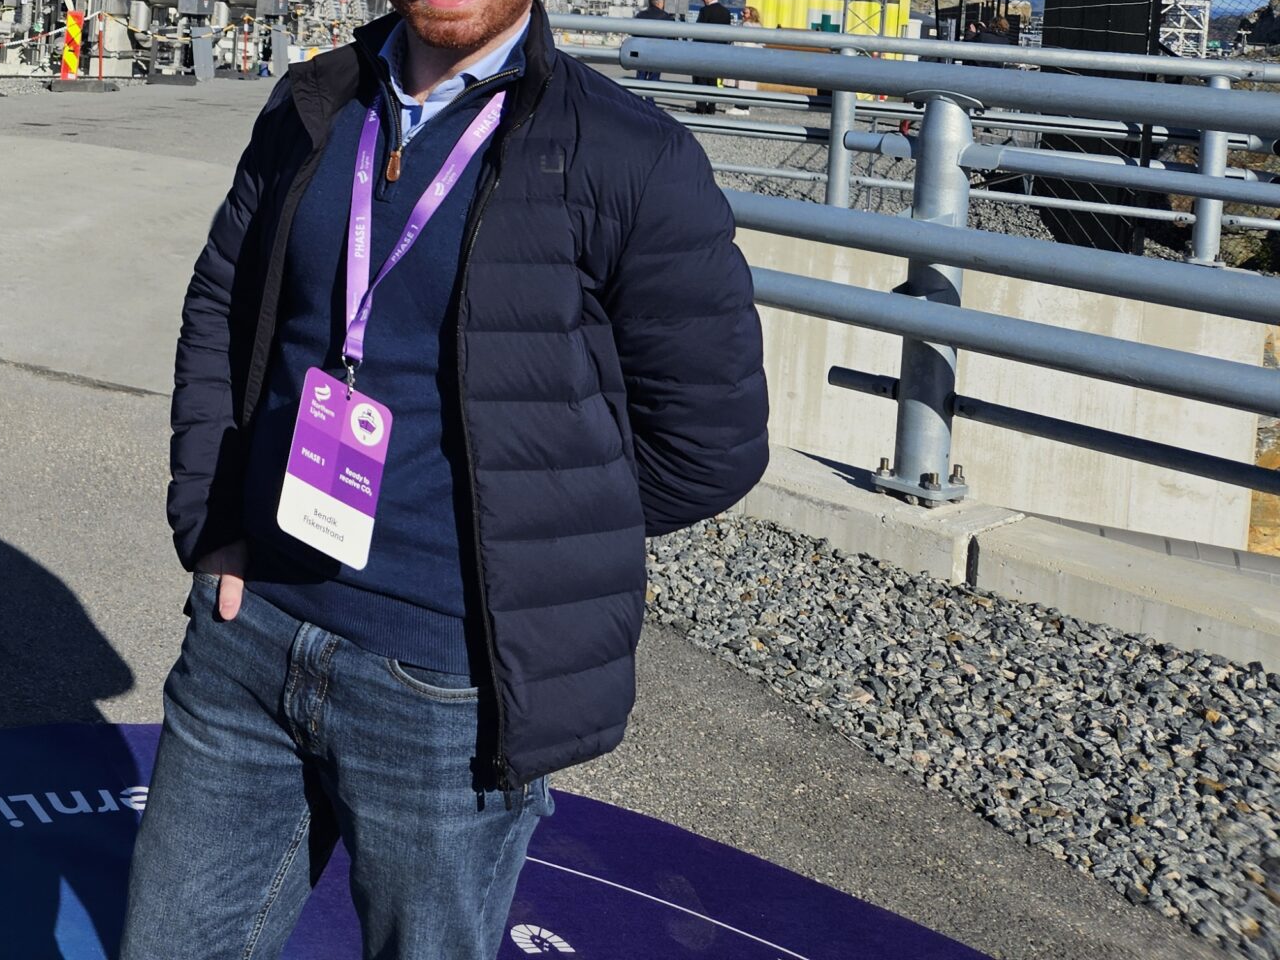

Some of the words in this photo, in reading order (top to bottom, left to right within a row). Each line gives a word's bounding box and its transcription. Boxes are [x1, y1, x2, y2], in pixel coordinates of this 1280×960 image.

[473, 109, 500, 138] PHASE
[354, 225, 366, 258] PHASE
[391, 232, 415, 262] PHASE
[301, 447, 321, 464] PHASE
[321, 458, 326, 467] 1
[339, 474, 360, 490] receive
[345, 467, 363, 482] Ready
[363, 475, 370, 485] to
[303, 514, 345, 542] Fiskerstrand
[313, 508, 337, 526] Bendik
